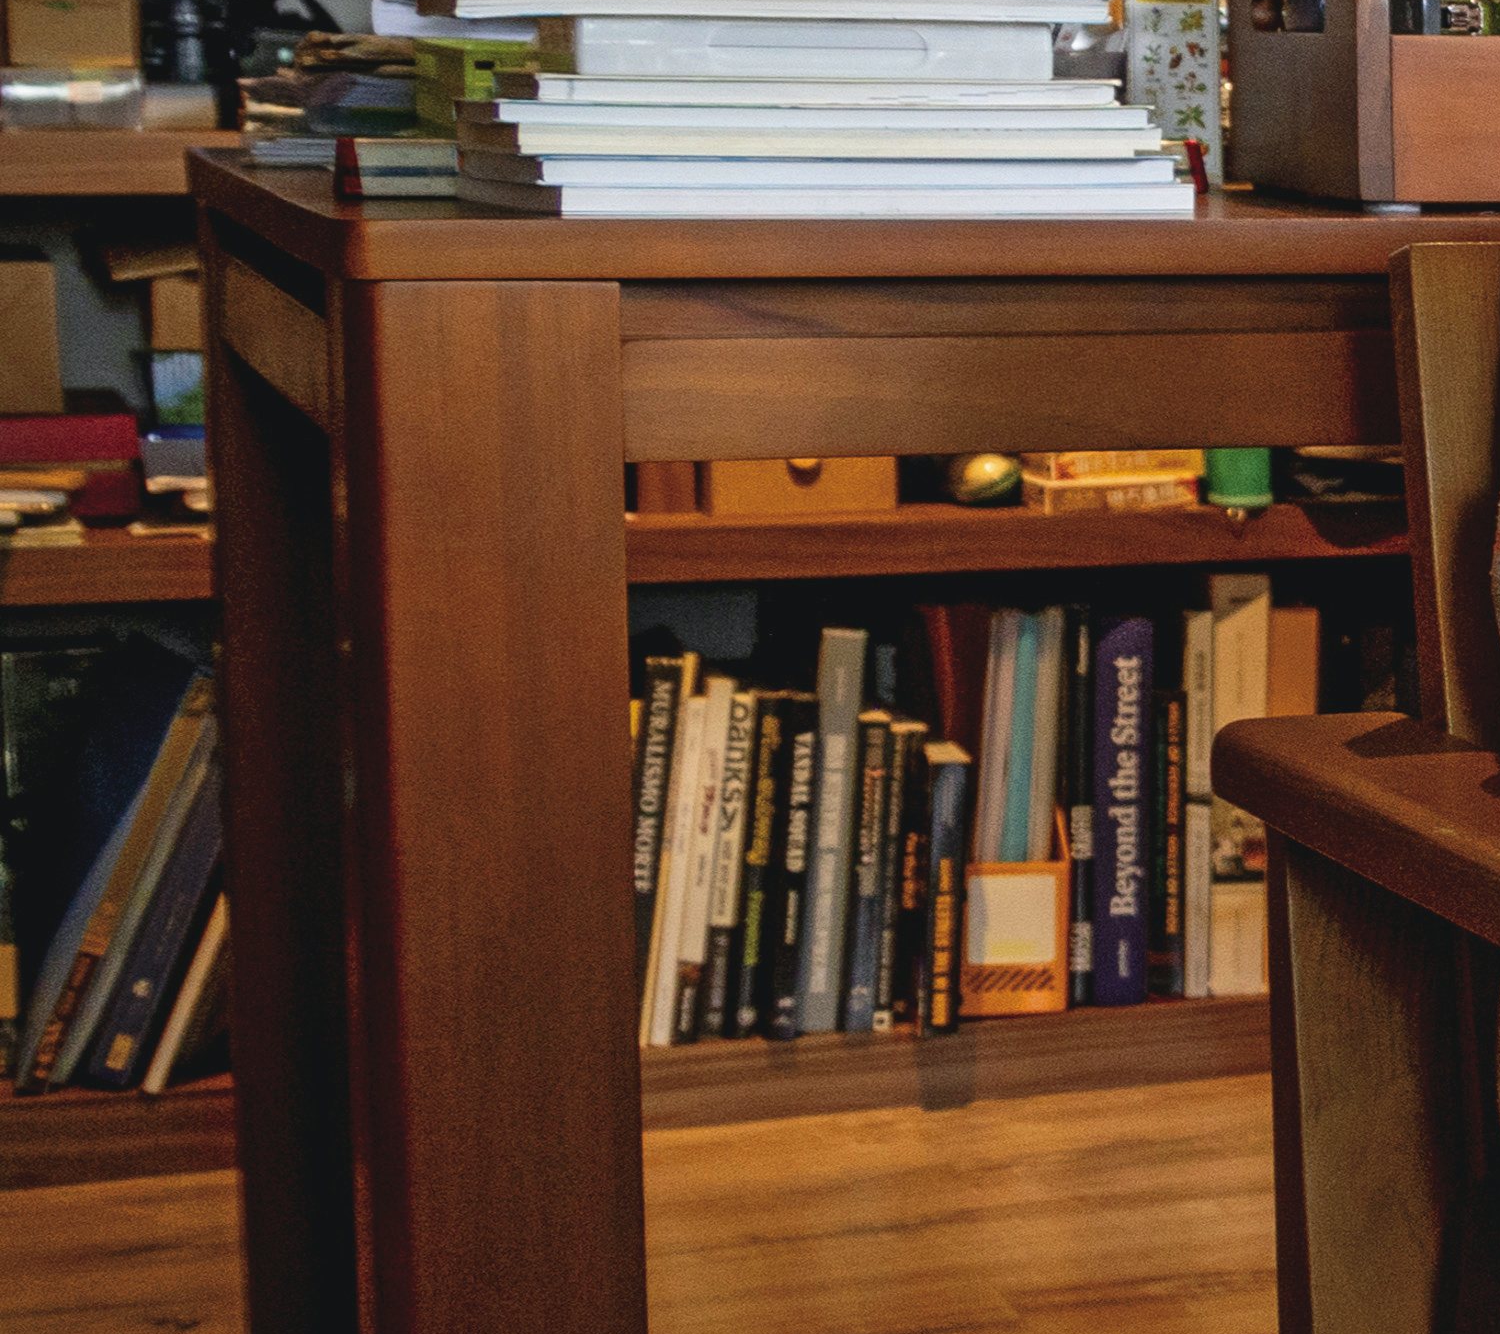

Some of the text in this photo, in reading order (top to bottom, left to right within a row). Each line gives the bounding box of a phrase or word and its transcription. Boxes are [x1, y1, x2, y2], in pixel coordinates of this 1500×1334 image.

[1110, 655, 1142, 746] Street
[790, 732, 814, 806] VANDAL
[1108, 750, 1140, 801] the
[1109, 805, 1143, 918] Beyond
